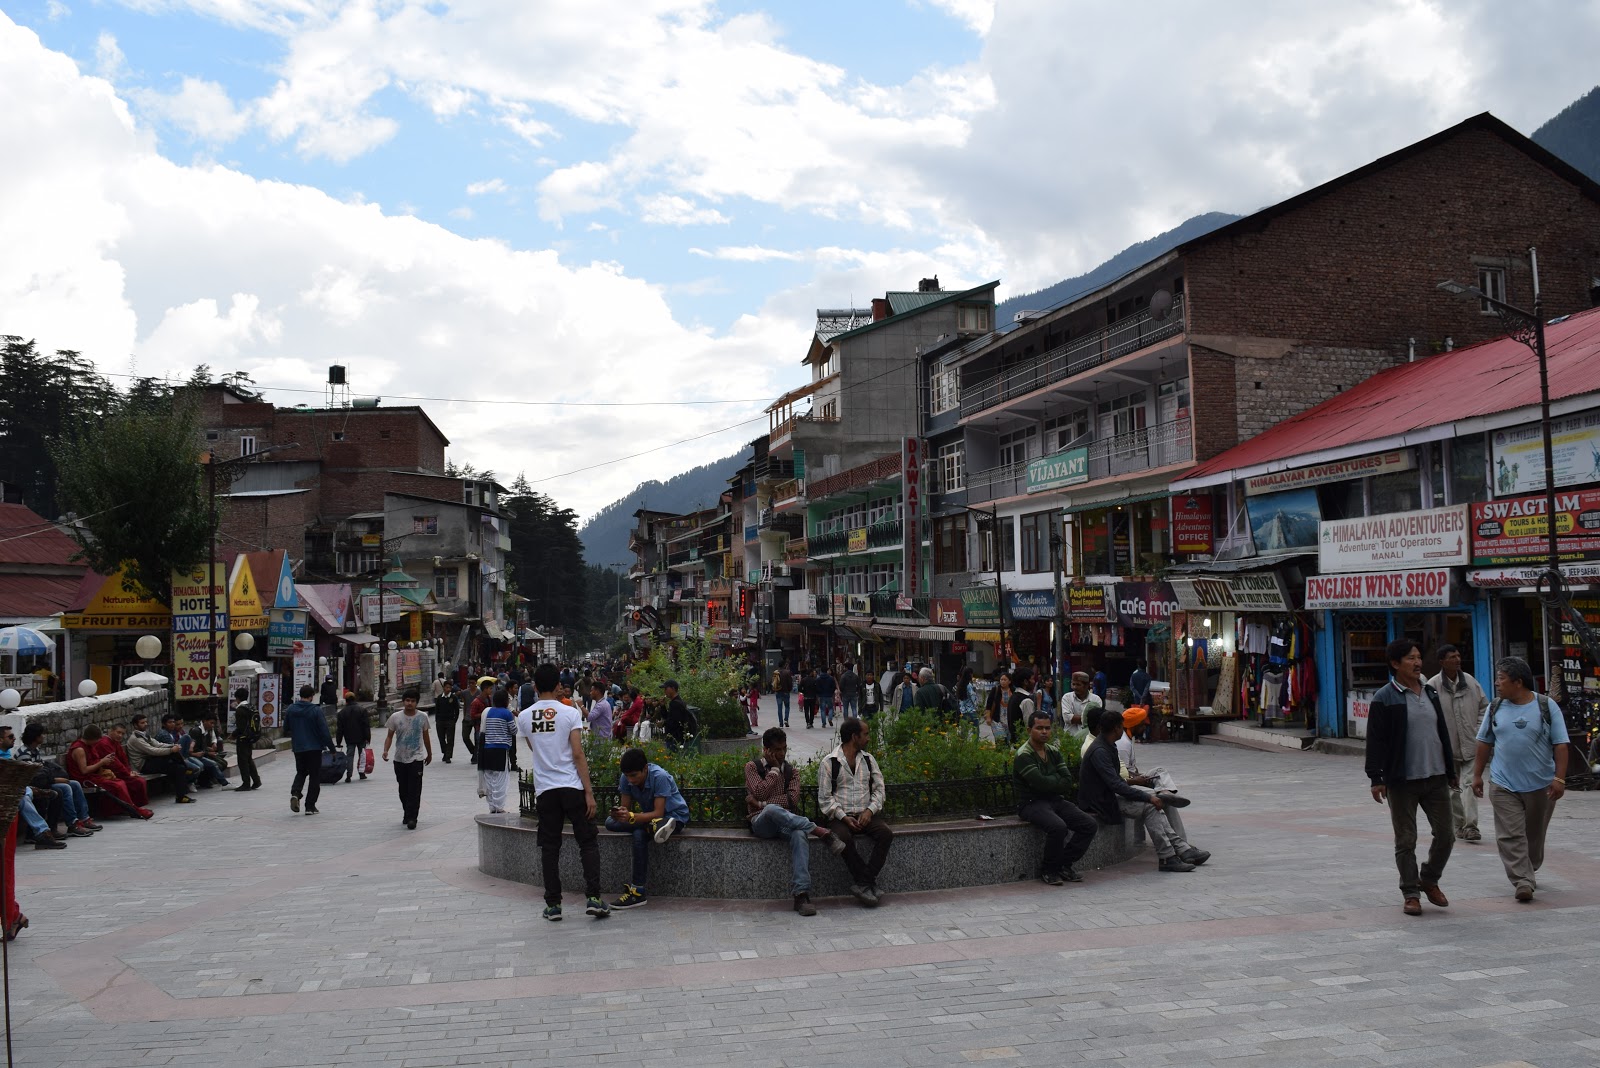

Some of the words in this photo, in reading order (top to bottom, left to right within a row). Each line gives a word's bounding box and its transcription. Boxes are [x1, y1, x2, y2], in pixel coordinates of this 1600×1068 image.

[1030, 459, 1047, 467] HOTEL
[1030, 457, 1085, 483] VIJAYANT
[1250, 471, 1305, 488] HIMALAYAN
[1307, 457, 1382, 478] ADVENTURES
[907, 438, 919, 516] DAWAT
[1483, 494, 1580, 520] SWAGTAM
[1175, 511, 1211, 522] Himalayan
[1510, 518, 1530, 527] TOURS
[1537, 514, 1568, 525] HOLAYS
[1175, 524, 1211, 532] Adventures
[1332, 519, 1386, 543] HIMALAYAN
[1388, 510, 1464, 538] ADVENTURERS
[1178, 533, 1209, 541] OFFICE
[1338, 543, 1376, 554] Adventure
[1380, 540, 1398, 549] Tour
[1400, 536, 1442, 550] Operators
[1371, 551, 1404, 560] MANALI
[173, 586, 201, 596] HIMACHAL
[1192, 579, 1238, 607] SHIVA
[1244, 575, 1278, 590] CORNER
[1307, 576, 1362, 600] ENGLISH
[1365, 574, 1403, 598] WINE
[1405, 571, 1447, 597] SHOP
[1014, 592, 1049, 606] Kashmir
[1070, 587, 1103, 599] Pashmina
[180, 598, 219, 610] HOTE
[1120, 597, 1147, 616] cafe
[1039, 606, 1057, 617] HOUS
[82, 617, 123, 626] FRUIT
[175, 615, 225, 631] KUNZM
[230, 619, 249, 628] FRUIT
[177, 665, 226, 681] FAGI
[181, 682, 223, 696] BAR
[531, 720, 556, 733] ME
